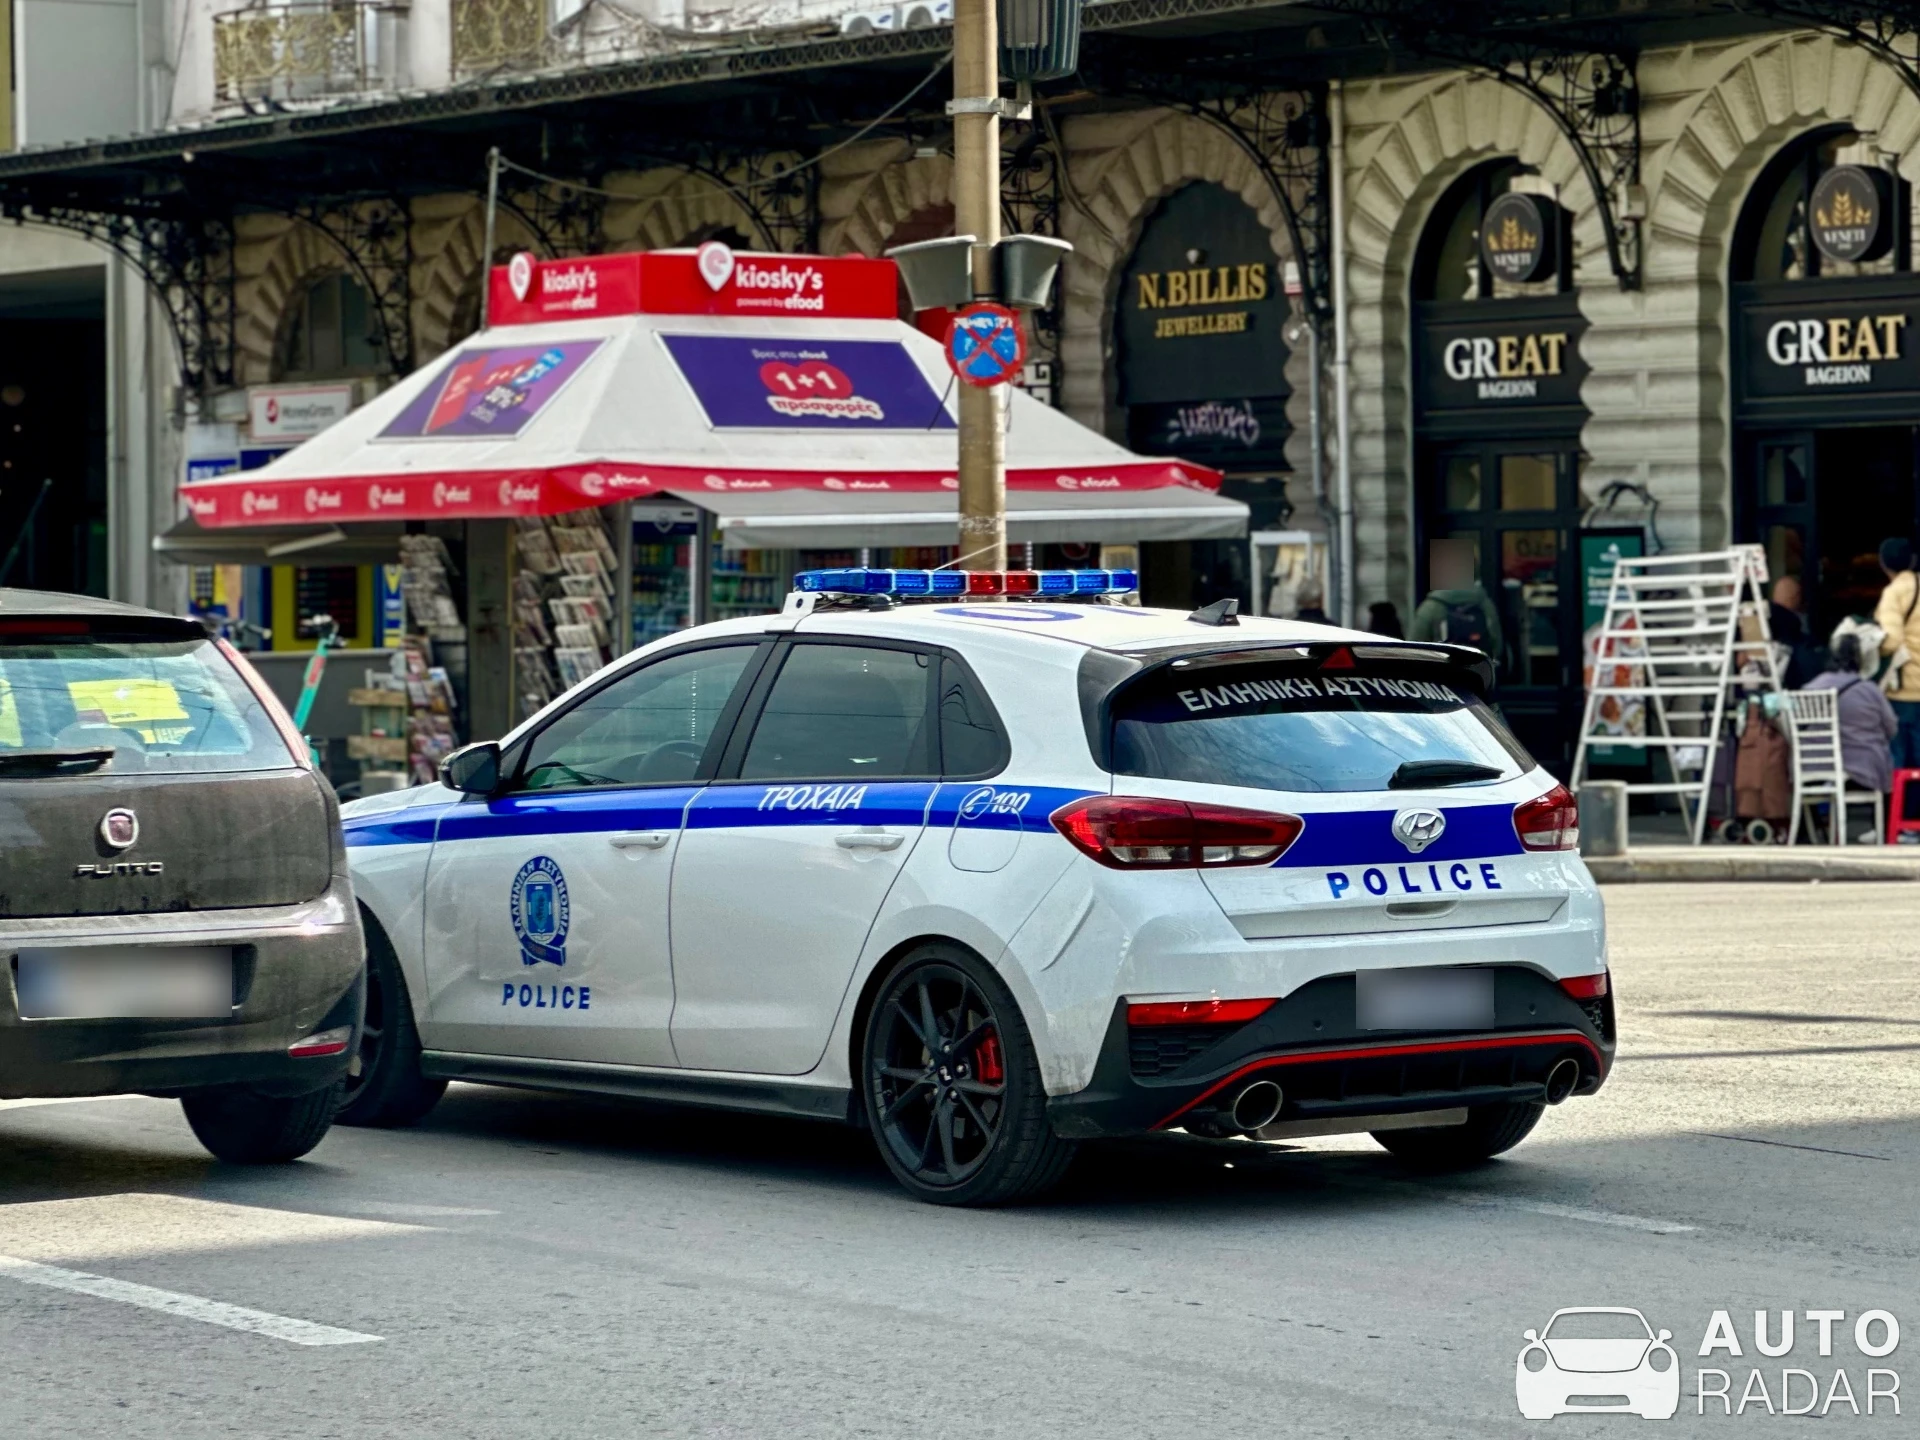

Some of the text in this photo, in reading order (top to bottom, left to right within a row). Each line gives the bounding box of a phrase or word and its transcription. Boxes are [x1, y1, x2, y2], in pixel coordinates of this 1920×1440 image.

[543, 265, 597, 294] kiosky's
[736, 263, 824, 293] kiosky's
[1138, 263, 1268, 309] N.BILLIS
[736, 298, 772, 308] powered
[785, 293, 825, 310] efood
[1155, 311, 1248, 339] JEWELLERY
[1766, 313, 1906, 366] GREAT
[1444, 332, 1567, 381] GREAT
[775, 371, 837, 391] 1+1
[1805, 364, 1871, 385] BAGEION
[1477, 380, 1537, 399] BAGEION
[775, 398, 879, 417] προσφορές
[1176, 676, 1465, 712] ΕΛΛΗΝΙΚΗ ΑΣΤΥΝΟΜΙΑ
[758, 786, 868, 811] ΤΡΟΧΑΙΑ
[993, 792, 1031, 814] 100
[1326, 863, 1502, 899] POLICE
[501, 983, 591, 1010] POLICE
